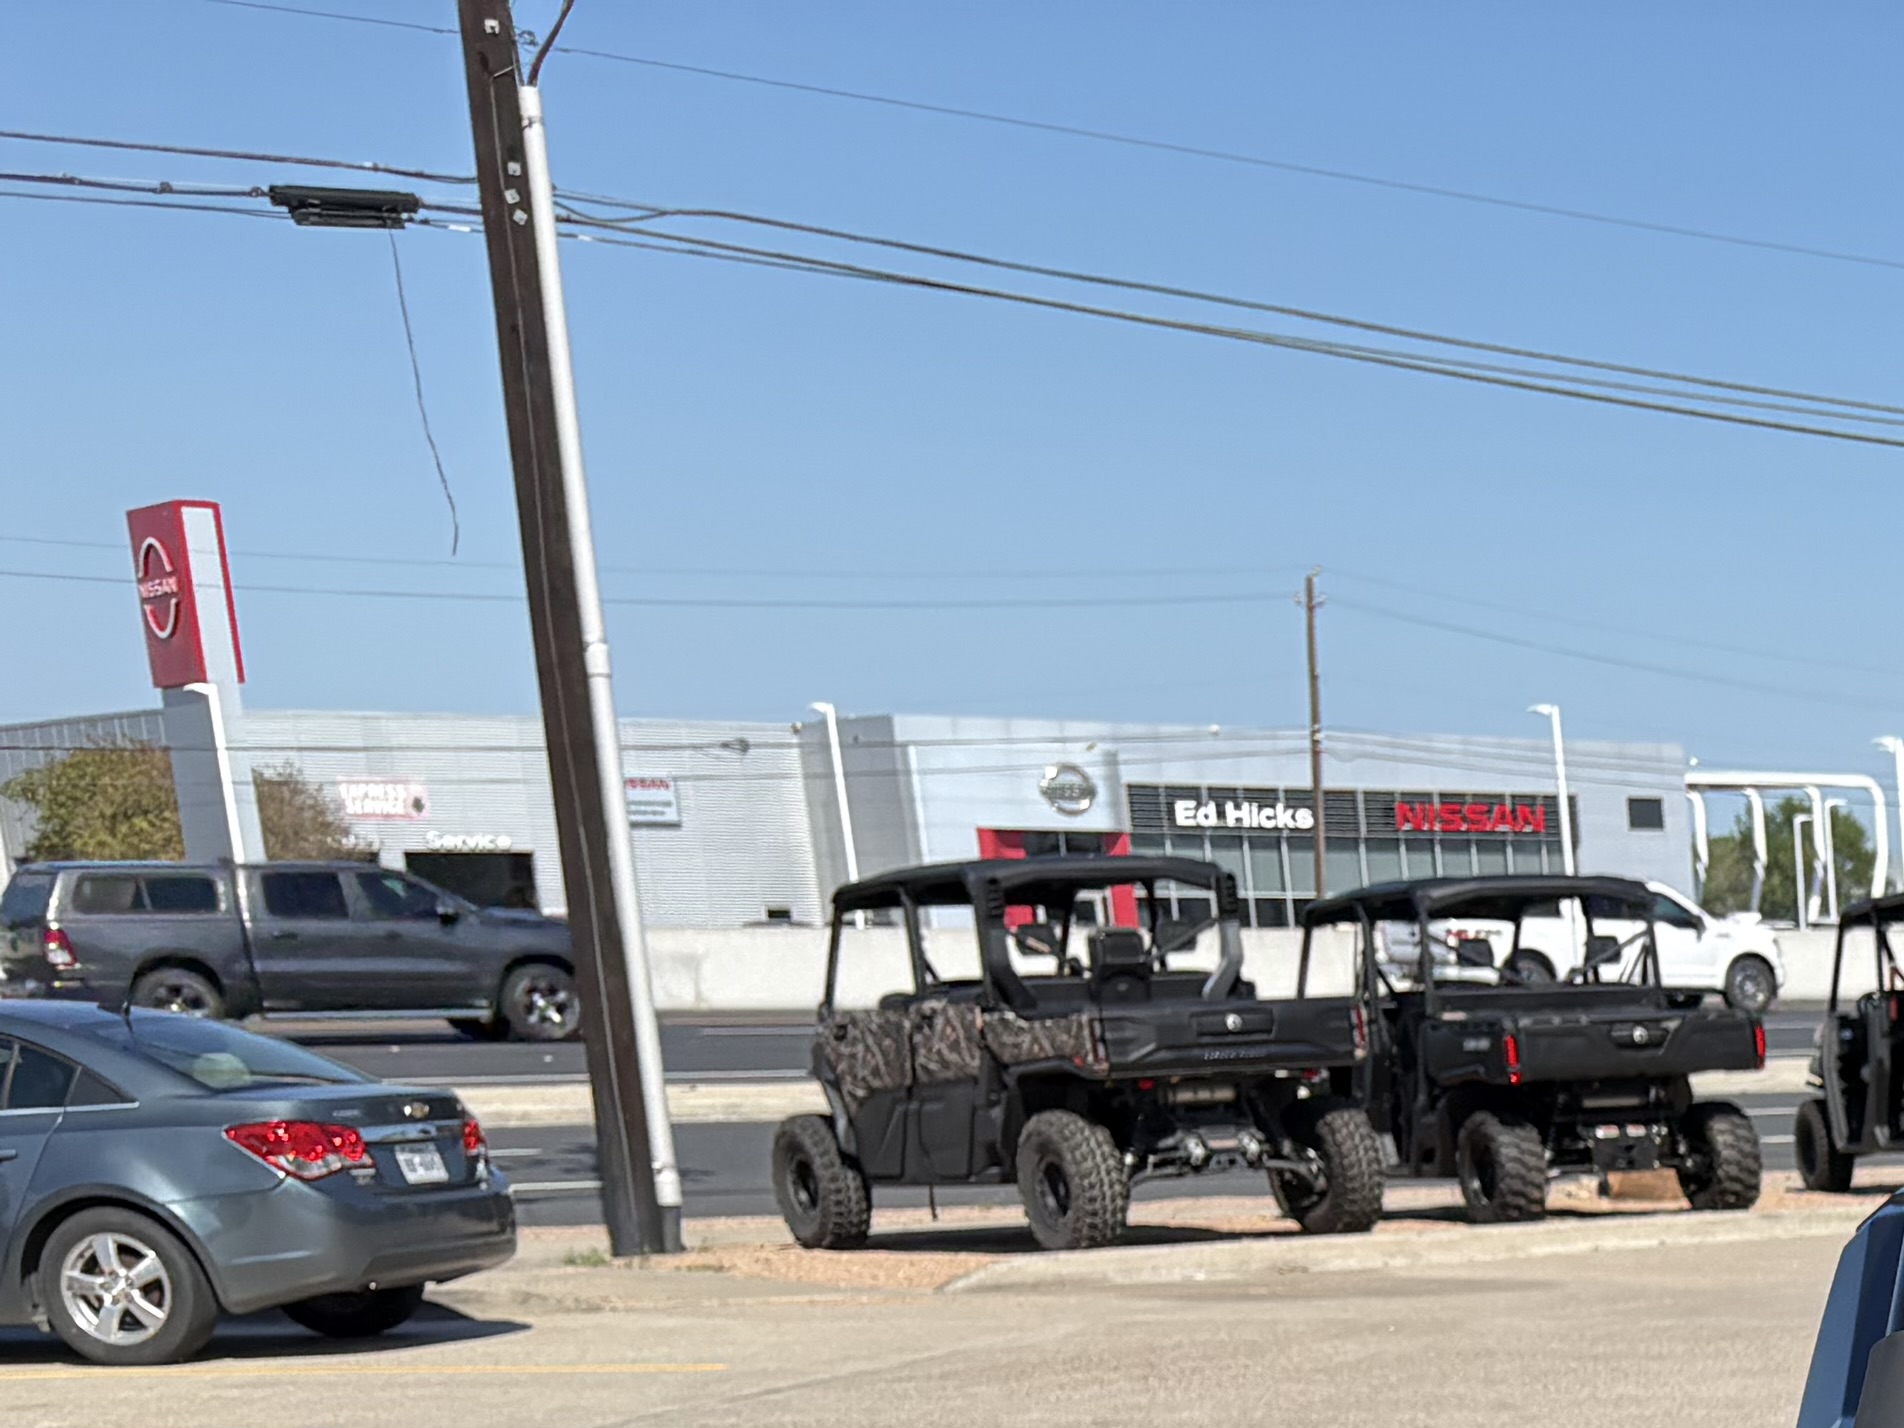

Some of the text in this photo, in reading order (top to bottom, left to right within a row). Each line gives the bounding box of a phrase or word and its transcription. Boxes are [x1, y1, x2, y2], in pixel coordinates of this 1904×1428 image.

[1174, 800, 1315, 829] Ed Hicks
[1395, 801, 1545, 832] NISSAN
[425, 830, 513, 850] Service
